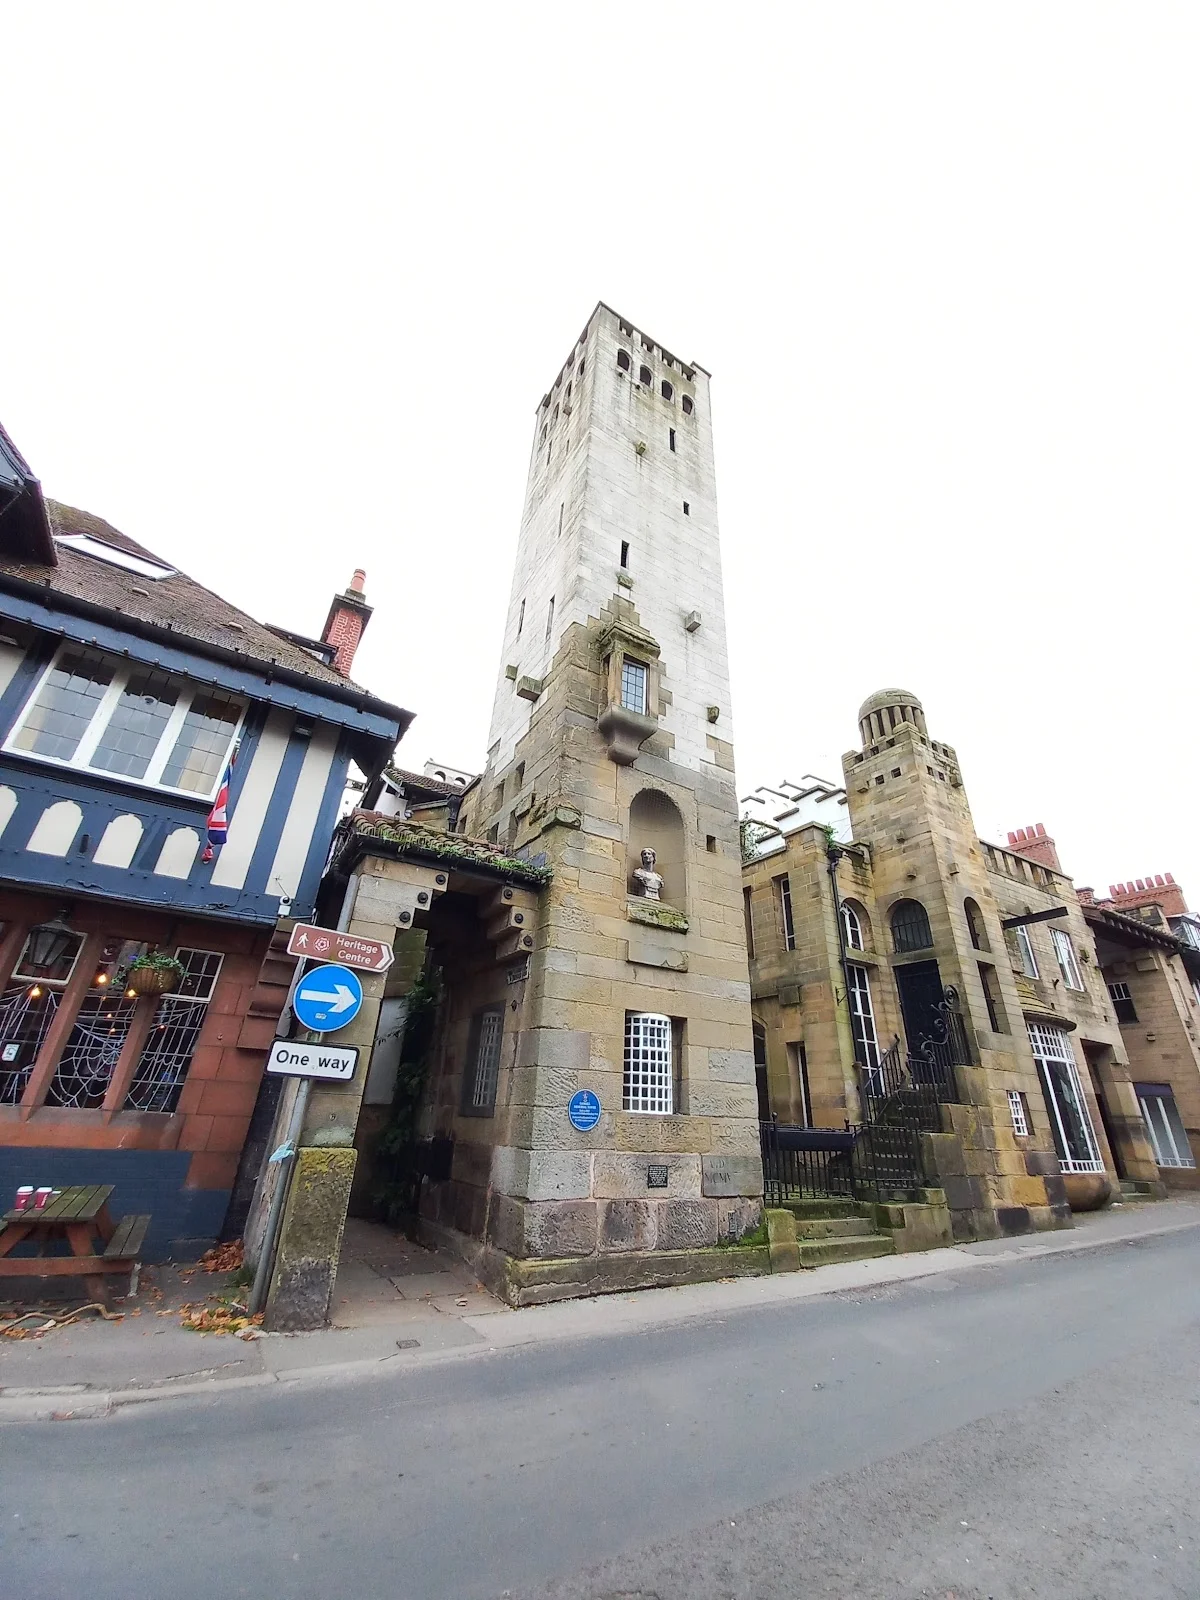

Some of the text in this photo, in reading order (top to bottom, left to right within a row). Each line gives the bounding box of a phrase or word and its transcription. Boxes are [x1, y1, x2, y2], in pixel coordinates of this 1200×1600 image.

[336, 936, 378, 954] Heritage
[337, 949, 371, 964] Centre
[276, 1049, 350, 1072] One way
